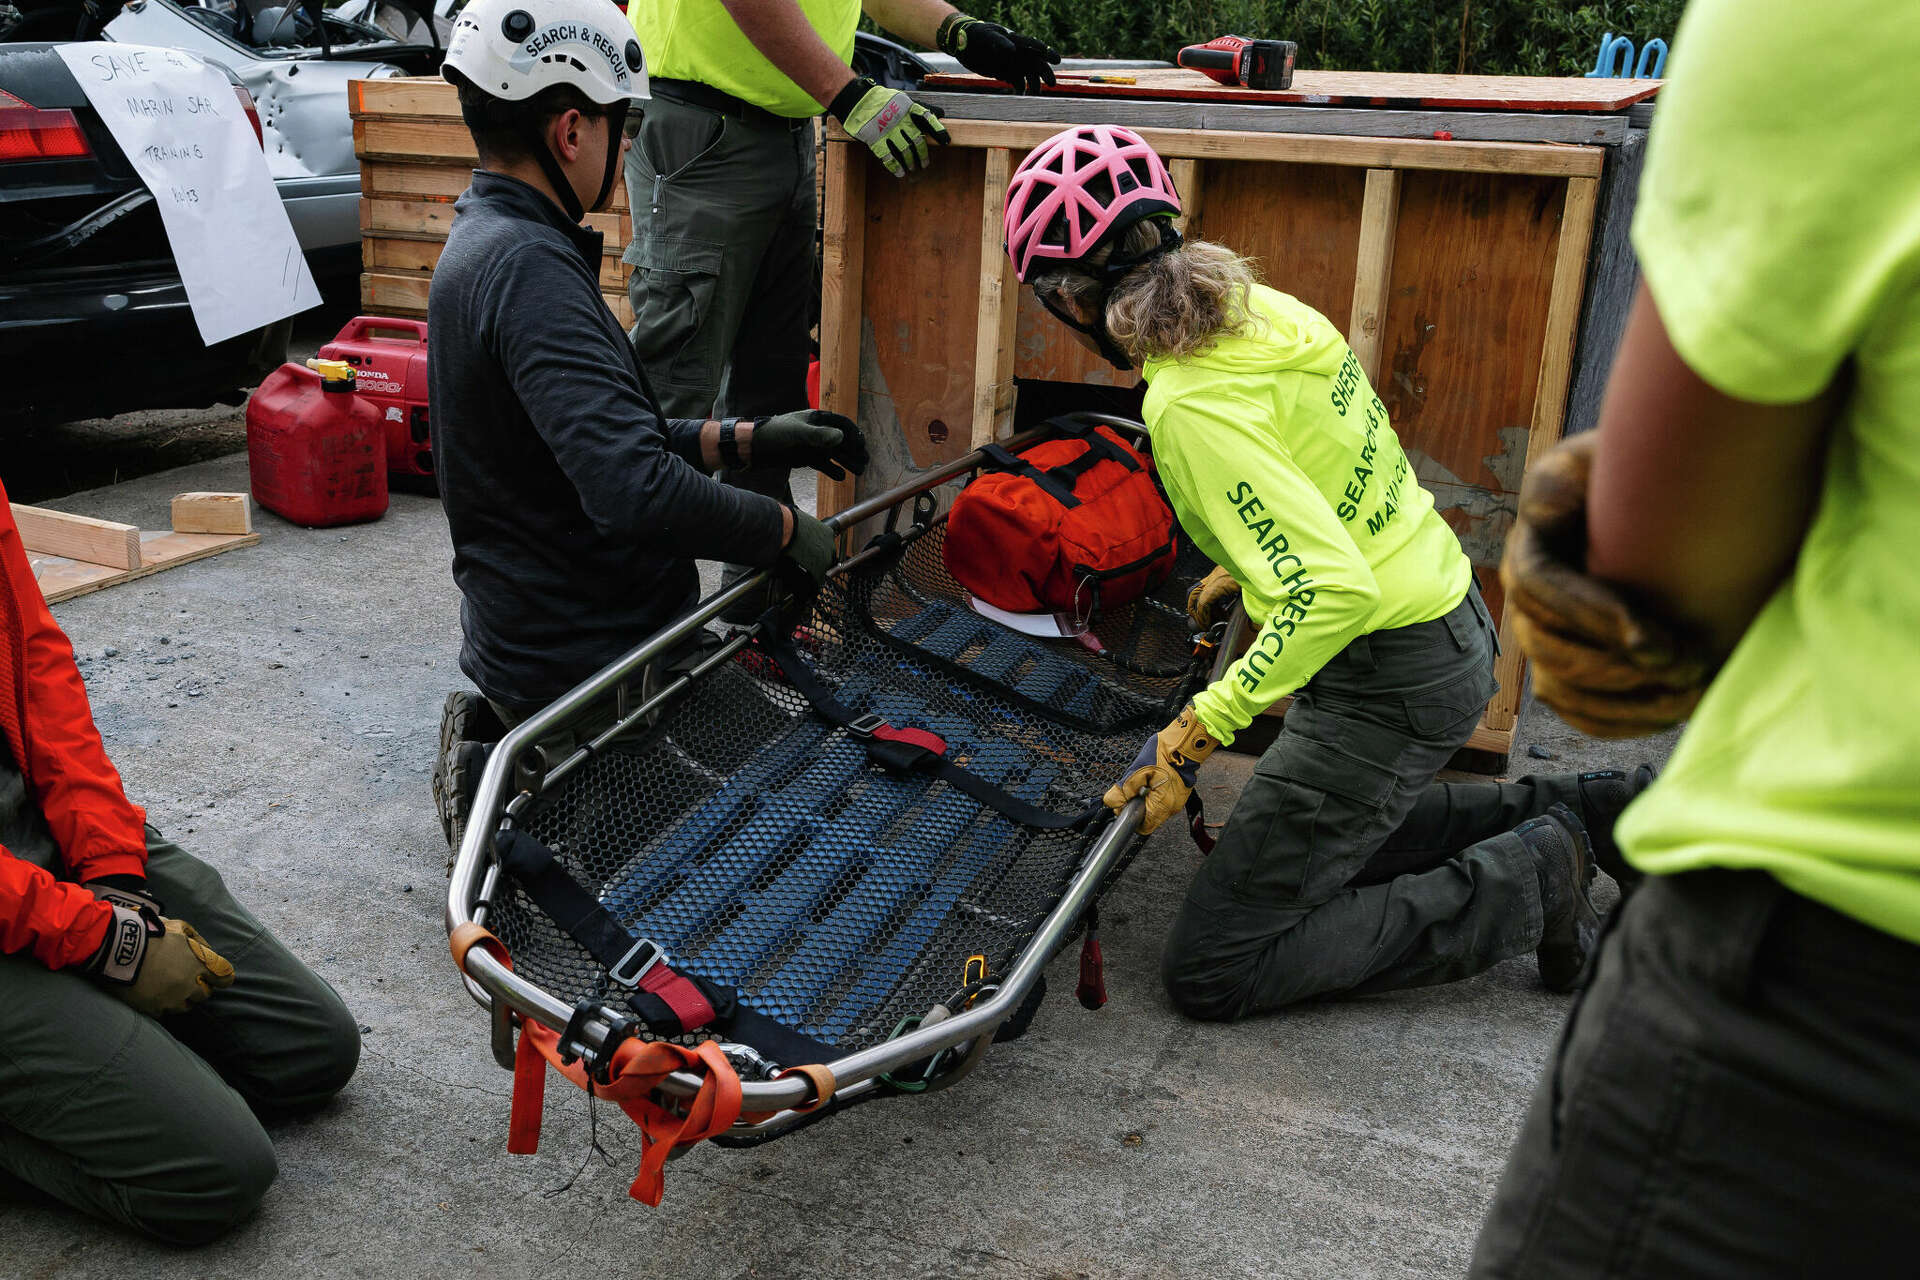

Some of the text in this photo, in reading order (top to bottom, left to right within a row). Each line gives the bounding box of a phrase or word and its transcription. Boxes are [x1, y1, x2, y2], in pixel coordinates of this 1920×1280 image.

[525, 25, 627, 83] SEARCH & RESCUE
[126, 95, 175, 119] MARIN
[145, 144, 204, 163] TRAINING
[1336, 419, 1377, 522] SEARCH
[1366, 408, 1379, 430] &
[1226, 480, 1316, 694] SEARCH RESCUE
[119, 925, 137, 960] PETZL
